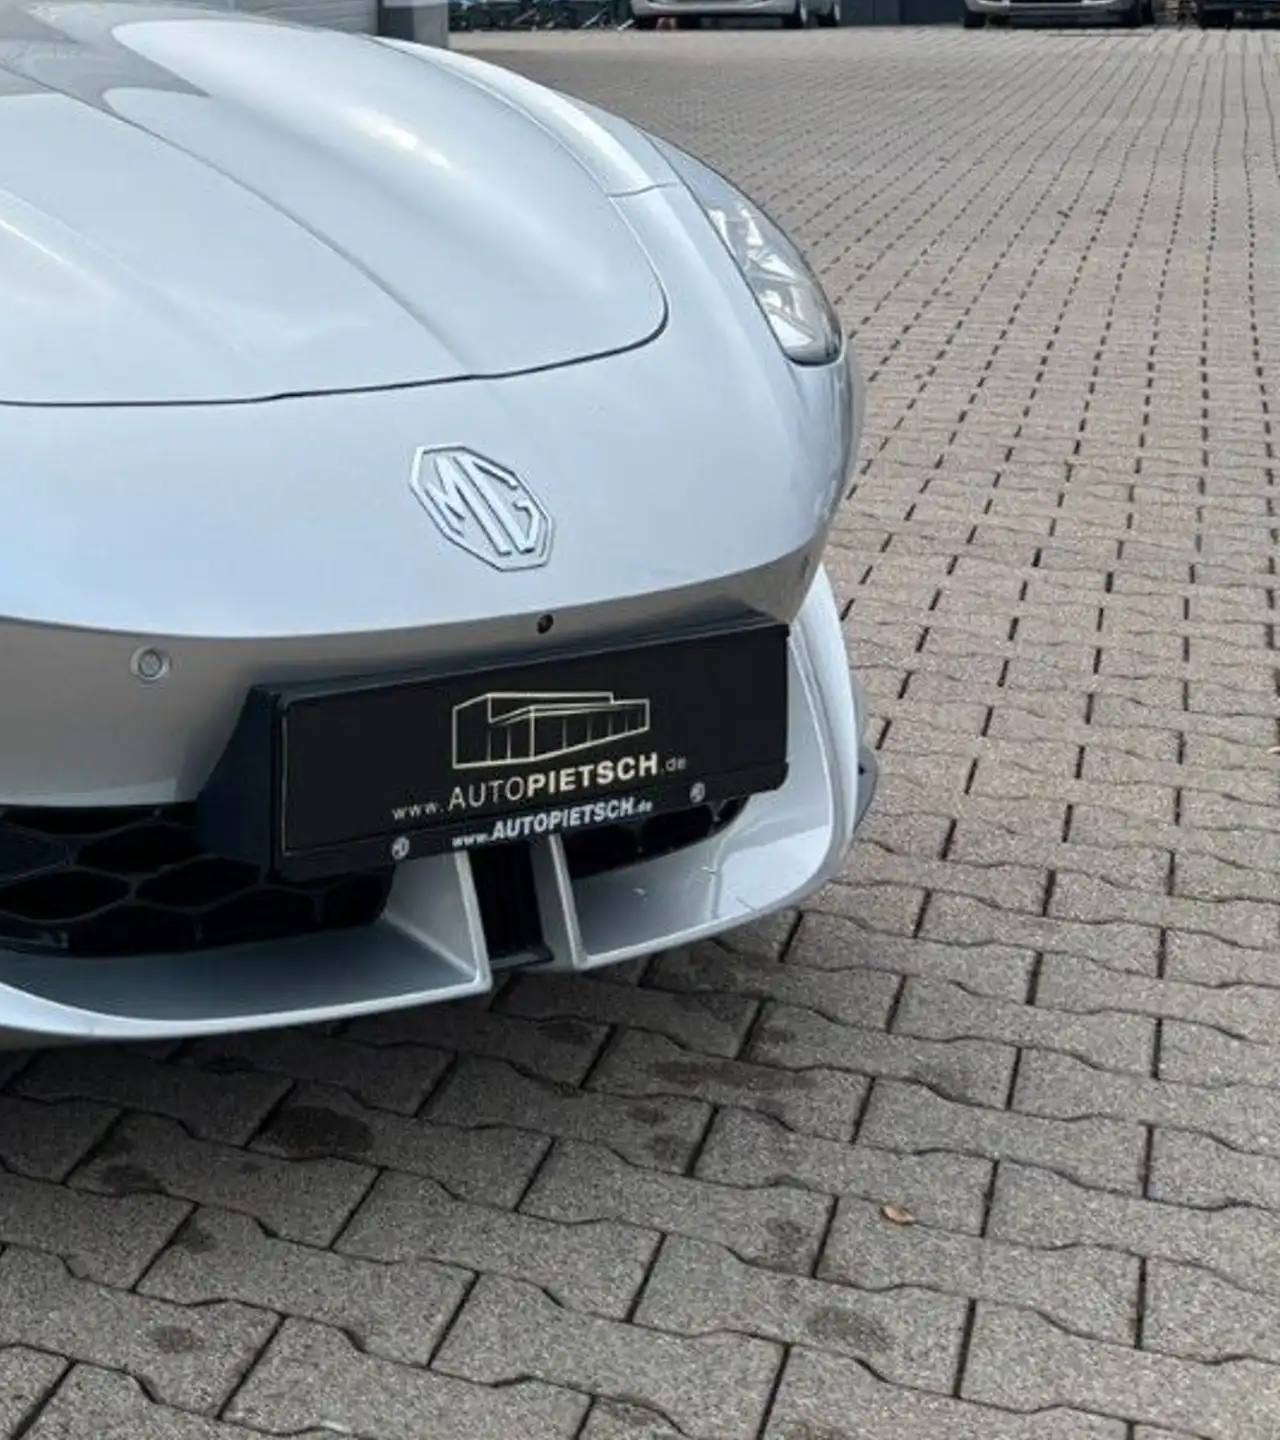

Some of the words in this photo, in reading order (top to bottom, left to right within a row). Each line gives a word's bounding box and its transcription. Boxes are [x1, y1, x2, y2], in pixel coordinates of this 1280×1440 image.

[422, 454, 540, 558] MG
[392, 753, 687, 821] www.AUTOPIETSCH.de
[452, 796, 653, 847] www.AUTOPIETSCH.de
